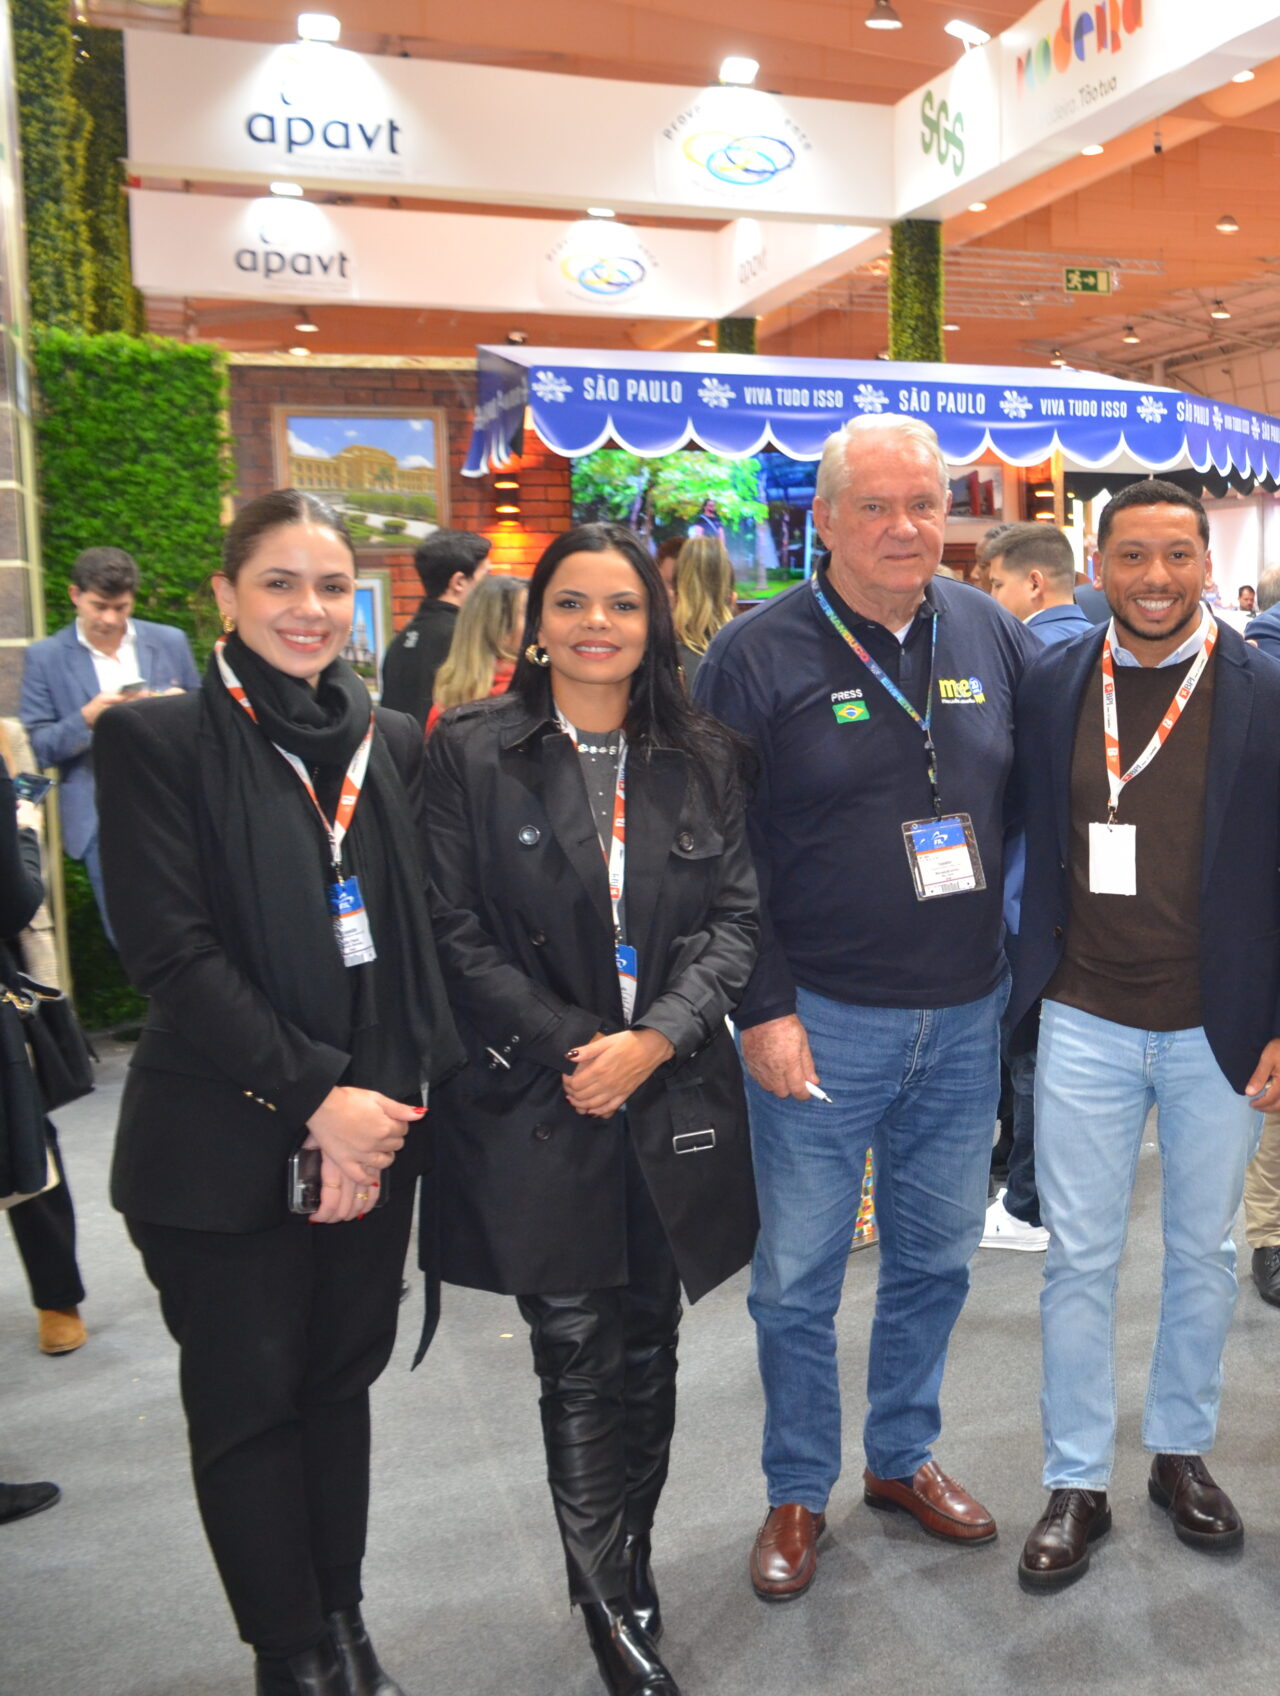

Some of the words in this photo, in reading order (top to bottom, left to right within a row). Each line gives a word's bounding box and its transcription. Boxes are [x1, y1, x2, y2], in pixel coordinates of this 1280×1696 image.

[246, 113, 400, 154] apavt
[921, 89, 964, 177] SGS
[233, 248, 349, 279] apavt
[583, 374, 619, 402] SÃO
[626, 378, 683, 404] PAULO
[744, 386, 773, 406] VIVA
[776, 387, 810, 408] TUDO
[813, 389, 844, 409] ISSO
[899, 387, 930, 413] SÃO
[937, 391, 986, 415] PAULO
[1040, 398, 1065, 416] VIVA
[1068, 399, 1098, 418] TUDO
[1101, 401, 1128, 419] ISSO
[1176, 399, 1193, 423] SÃO
[1193, 404, 1210, 427] PAULO
[815, 591, 870, 663] PERNAMBUCO
[831, 688, 863, 702] PRESS
[1183, 676, 1195, 691] BPI
[1130, 764, 1142, 776] BPI
